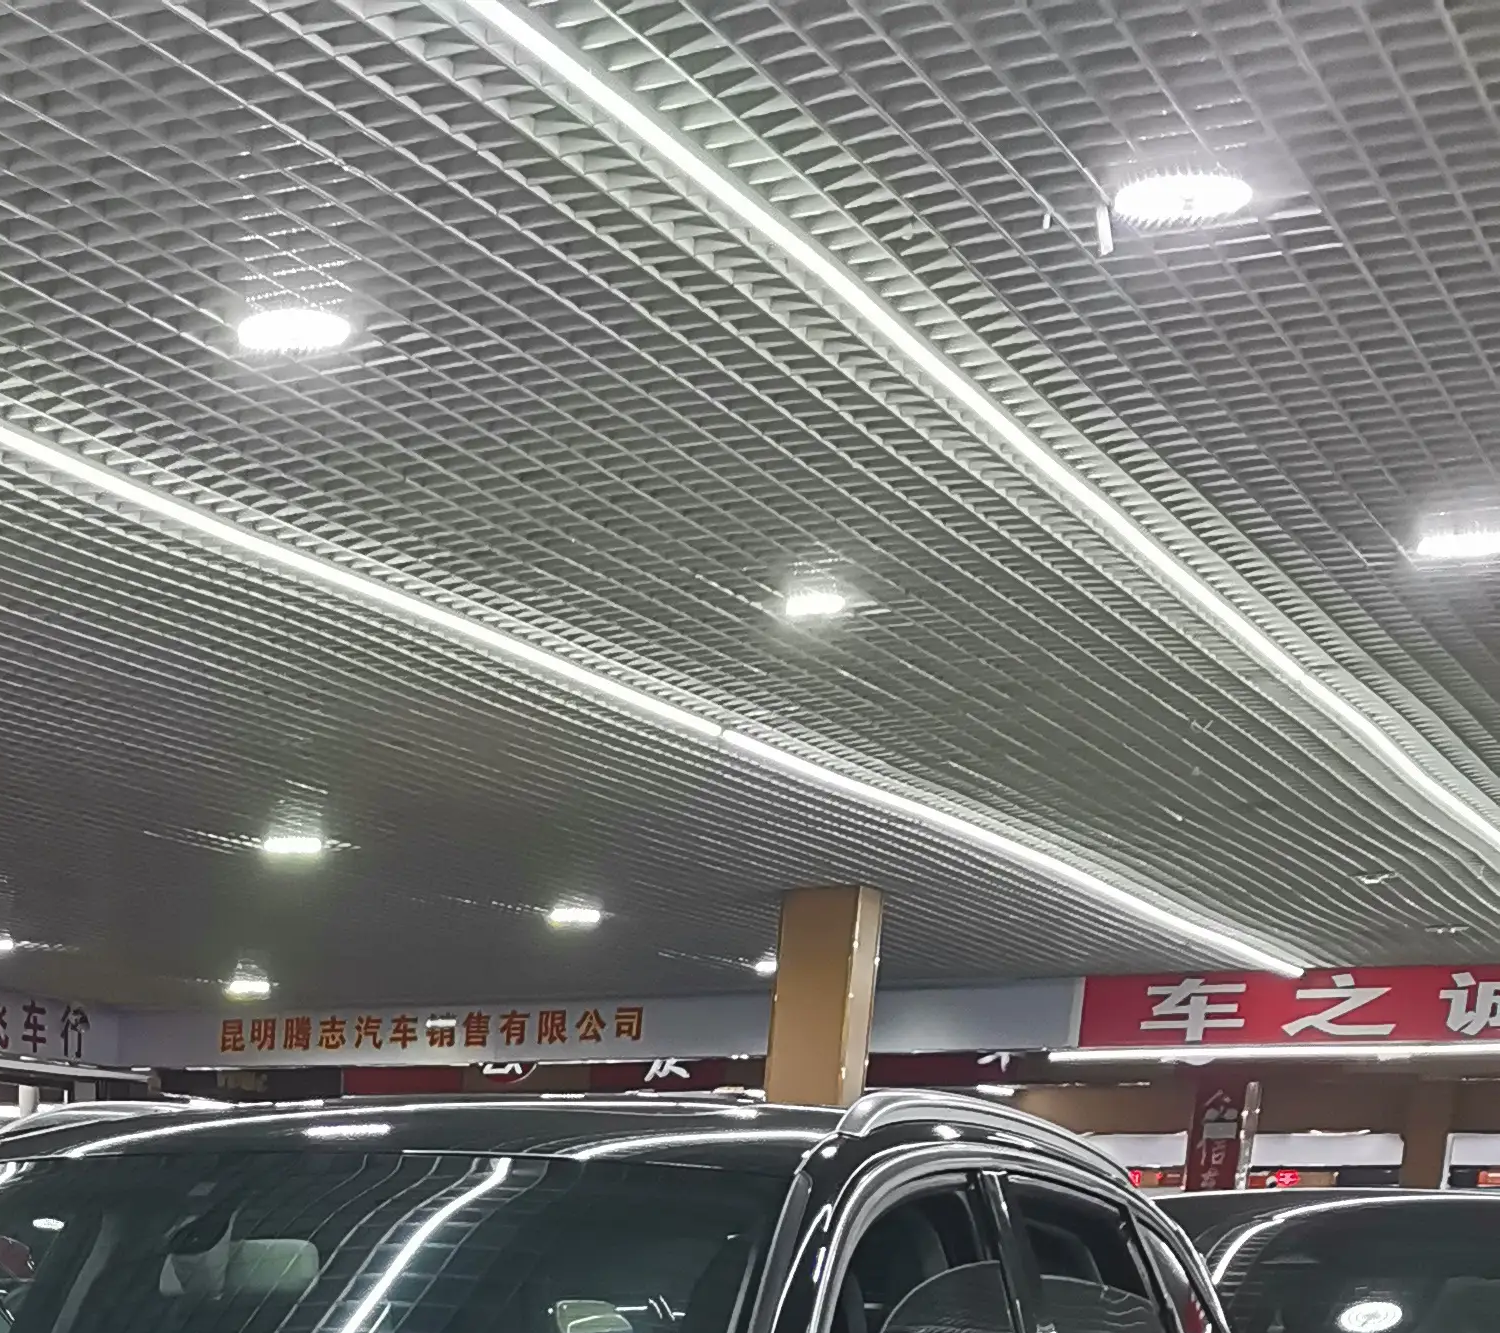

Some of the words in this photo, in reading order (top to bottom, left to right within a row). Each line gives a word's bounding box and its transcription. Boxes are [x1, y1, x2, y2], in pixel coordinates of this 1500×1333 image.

[220, 1006, 644, 1053] 昆明腾志汽车销售有限公司
